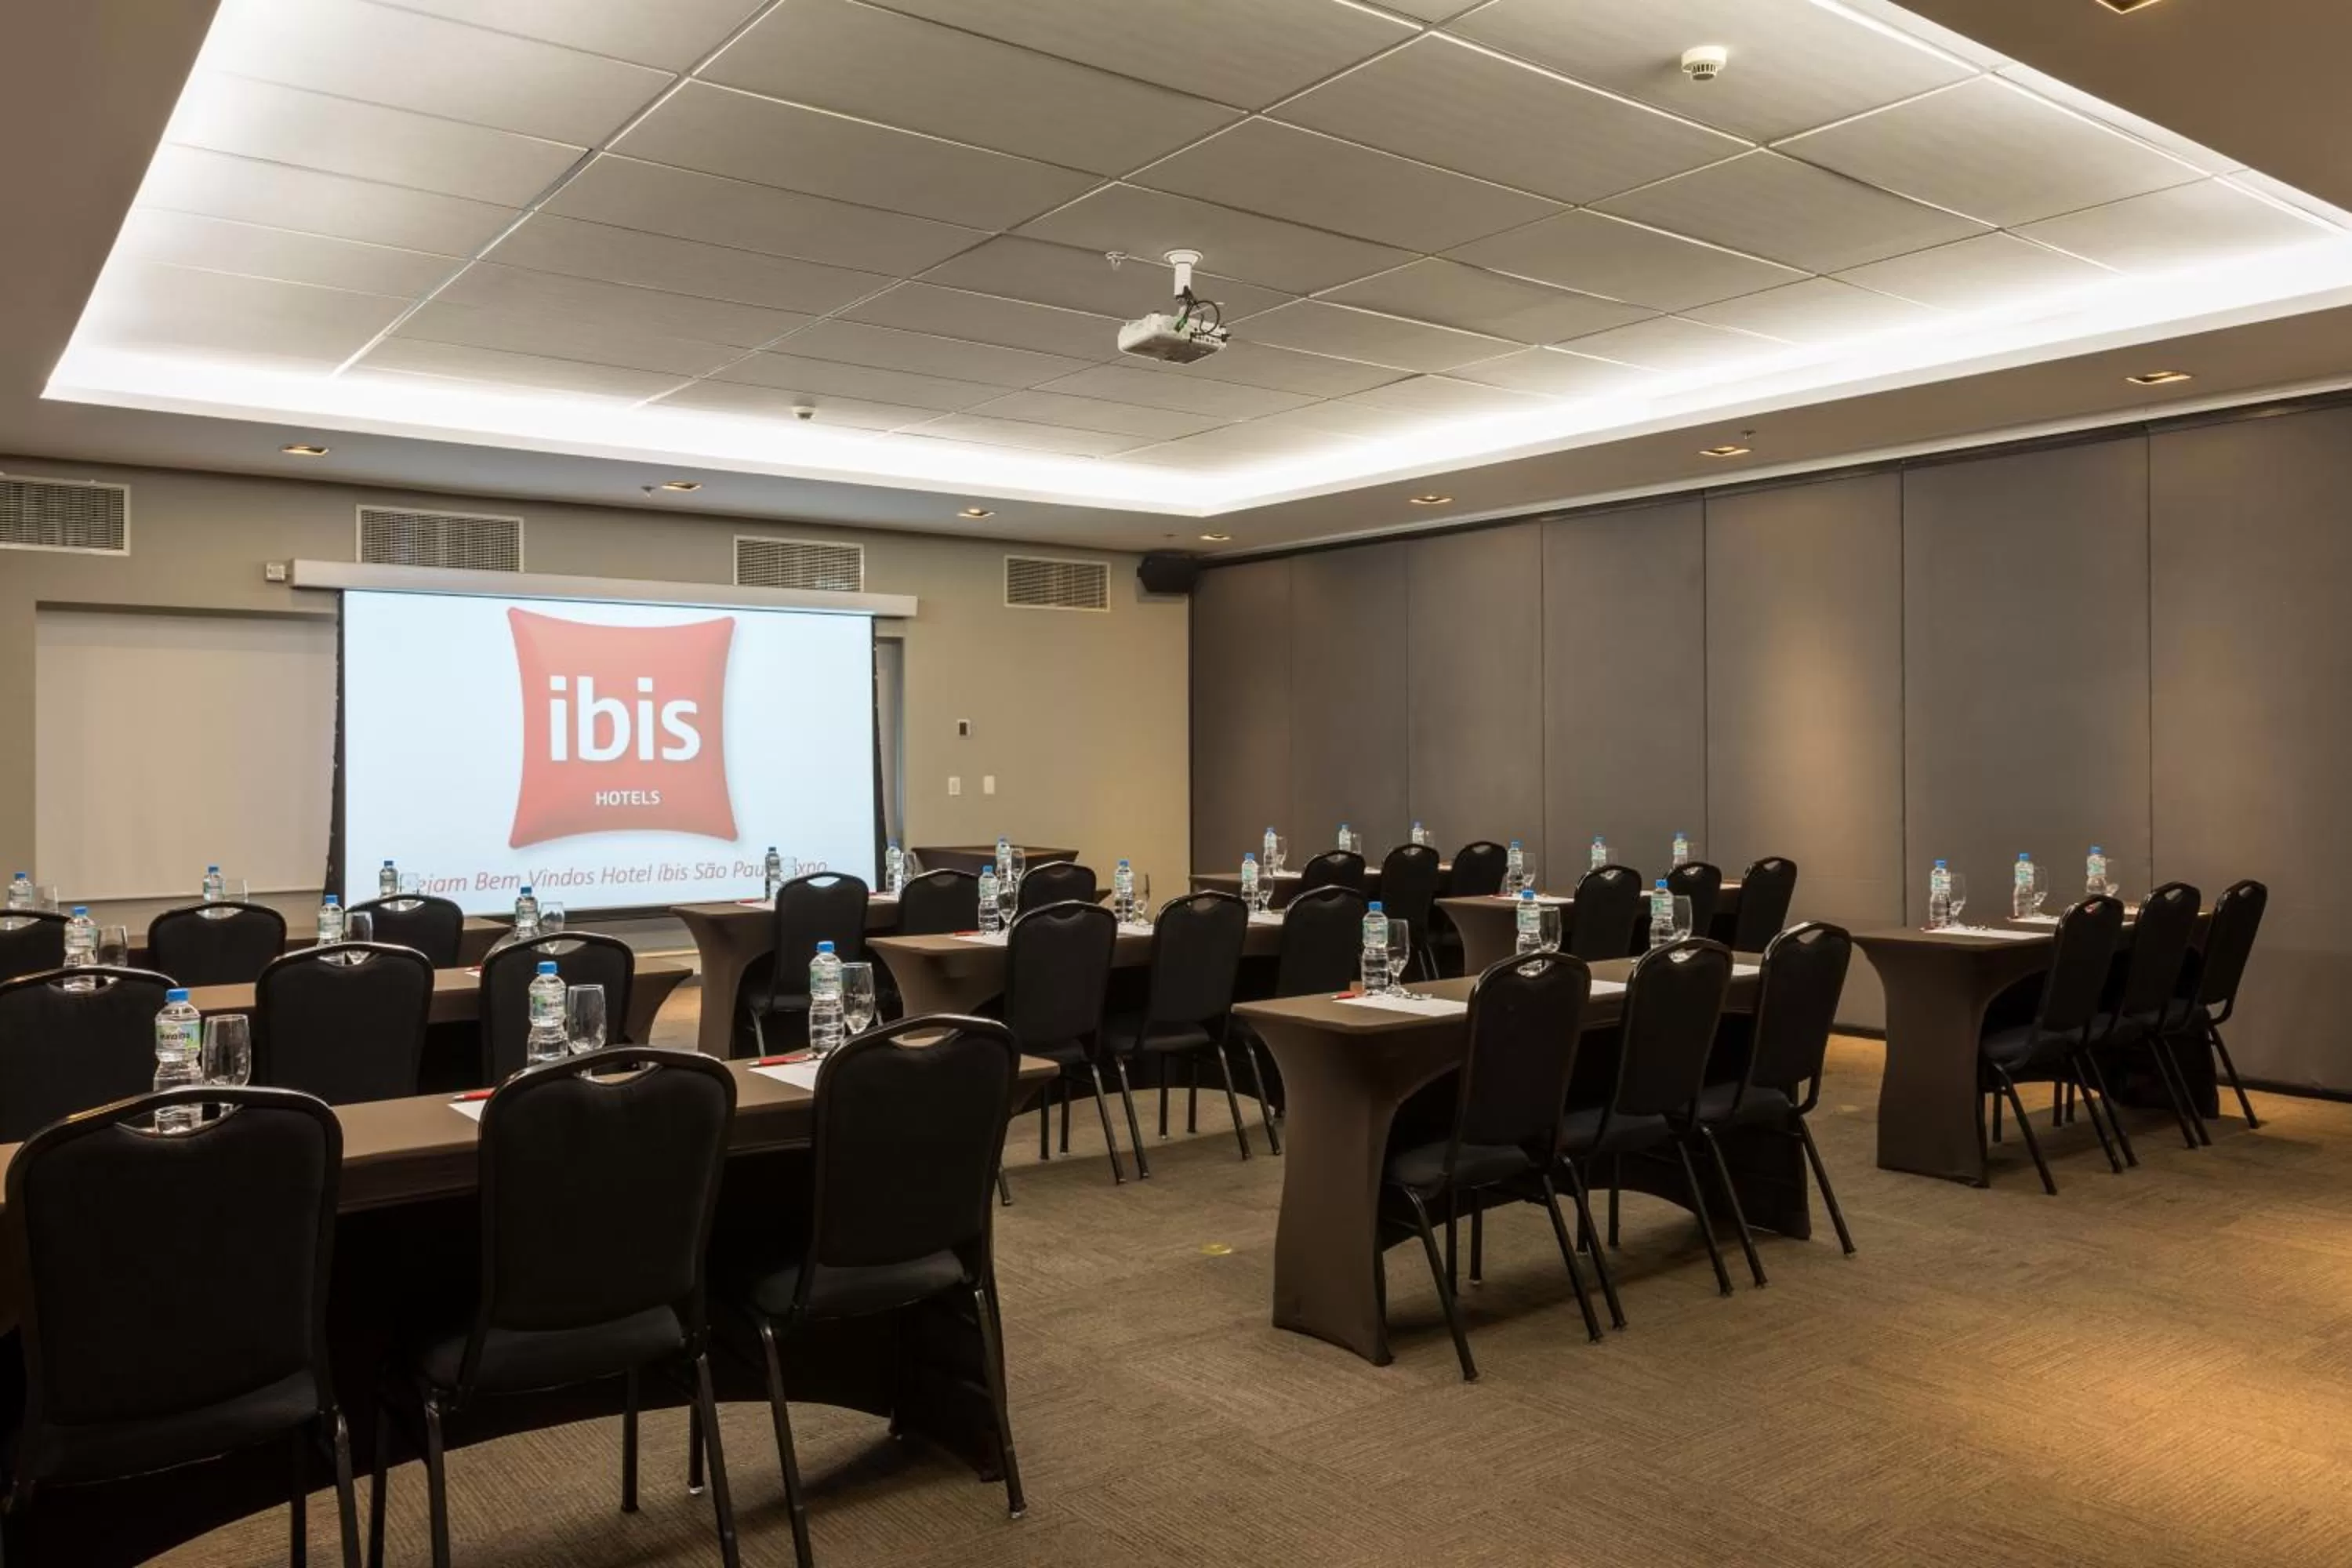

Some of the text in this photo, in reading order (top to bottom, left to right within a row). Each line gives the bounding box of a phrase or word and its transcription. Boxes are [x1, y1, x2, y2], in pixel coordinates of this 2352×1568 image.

[550, 675, 702, 761] ibis
[595, 789, 661, 806] HOTELS
[418, 873, 468, 895] ejam
[474, 870, 521, 891] Bem
[528, 866, 595, 887] Vindos
[601, 863, 653, 884] Hotel
[658, 862, 688, 882] Ibis
[693, 862, 728, 880] São
[733, 859, 767, 878] Pau
